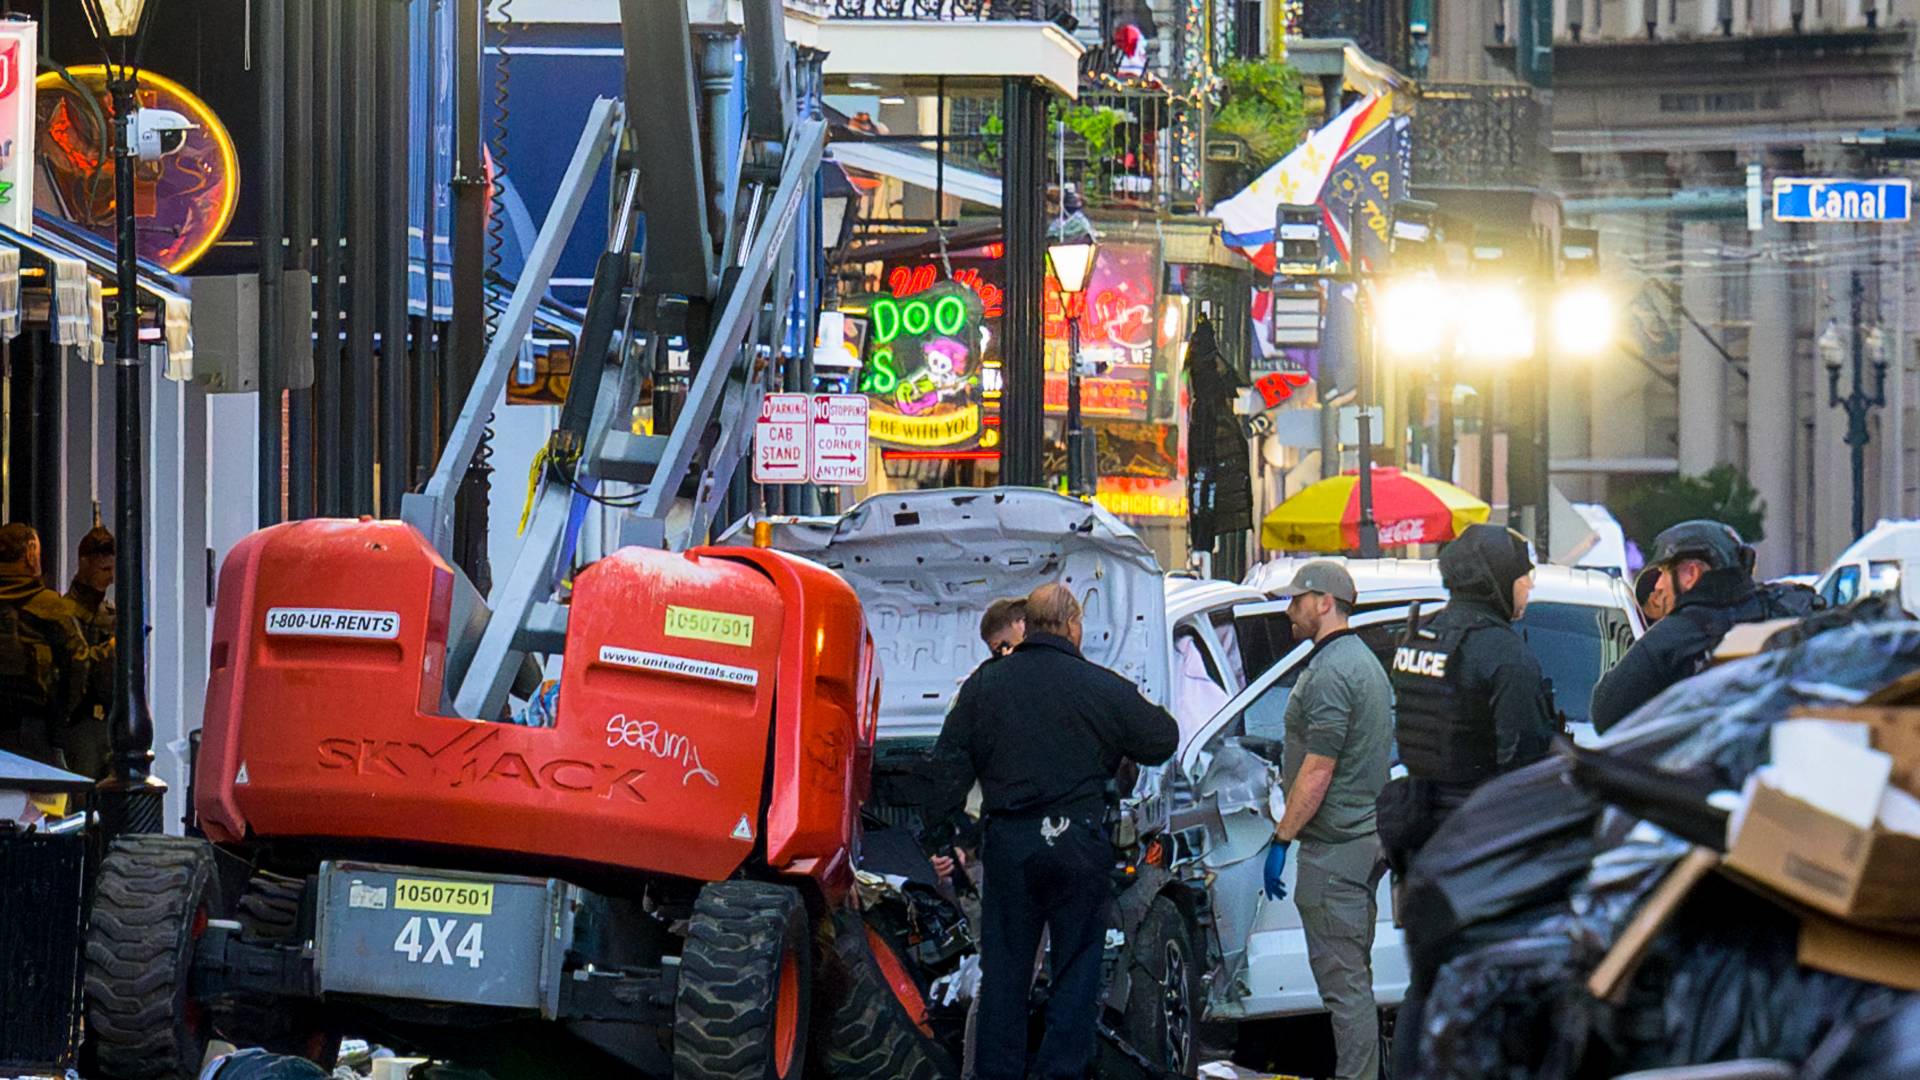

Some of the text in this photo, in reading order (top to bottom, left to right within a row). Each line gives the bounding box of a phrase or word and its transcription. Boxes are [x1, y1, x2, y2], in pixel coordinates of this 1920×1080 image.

[1808, 184, 1886, 218] Canal
[771, 403, 806, 414] PARKING
[815, 398, 865, 419] NO STOPPING
[769, 427, 793, 441] CAB
[834, 427, 847, 436] TO
[880, 420, 898, 435] BE
[903, 424, 938, 439] WITH
[946, 415, 973, 437] YOU
[762, 446, 800, 460] STAND
[818, 440, 862, 450] CORNER
[816, 466, 862, 478] ANYTIME
[269, 613, 394, 633] 1-800-UR-RENTS
[667, 607, 751, 639] 10507501
[602, 650, 754, 683] www.unitedrentals.com
[318, 726, 648, 803] SKYJACK
[397, 884, 490, 907] 10507501
[393, 916, 485, 968] 4X4
